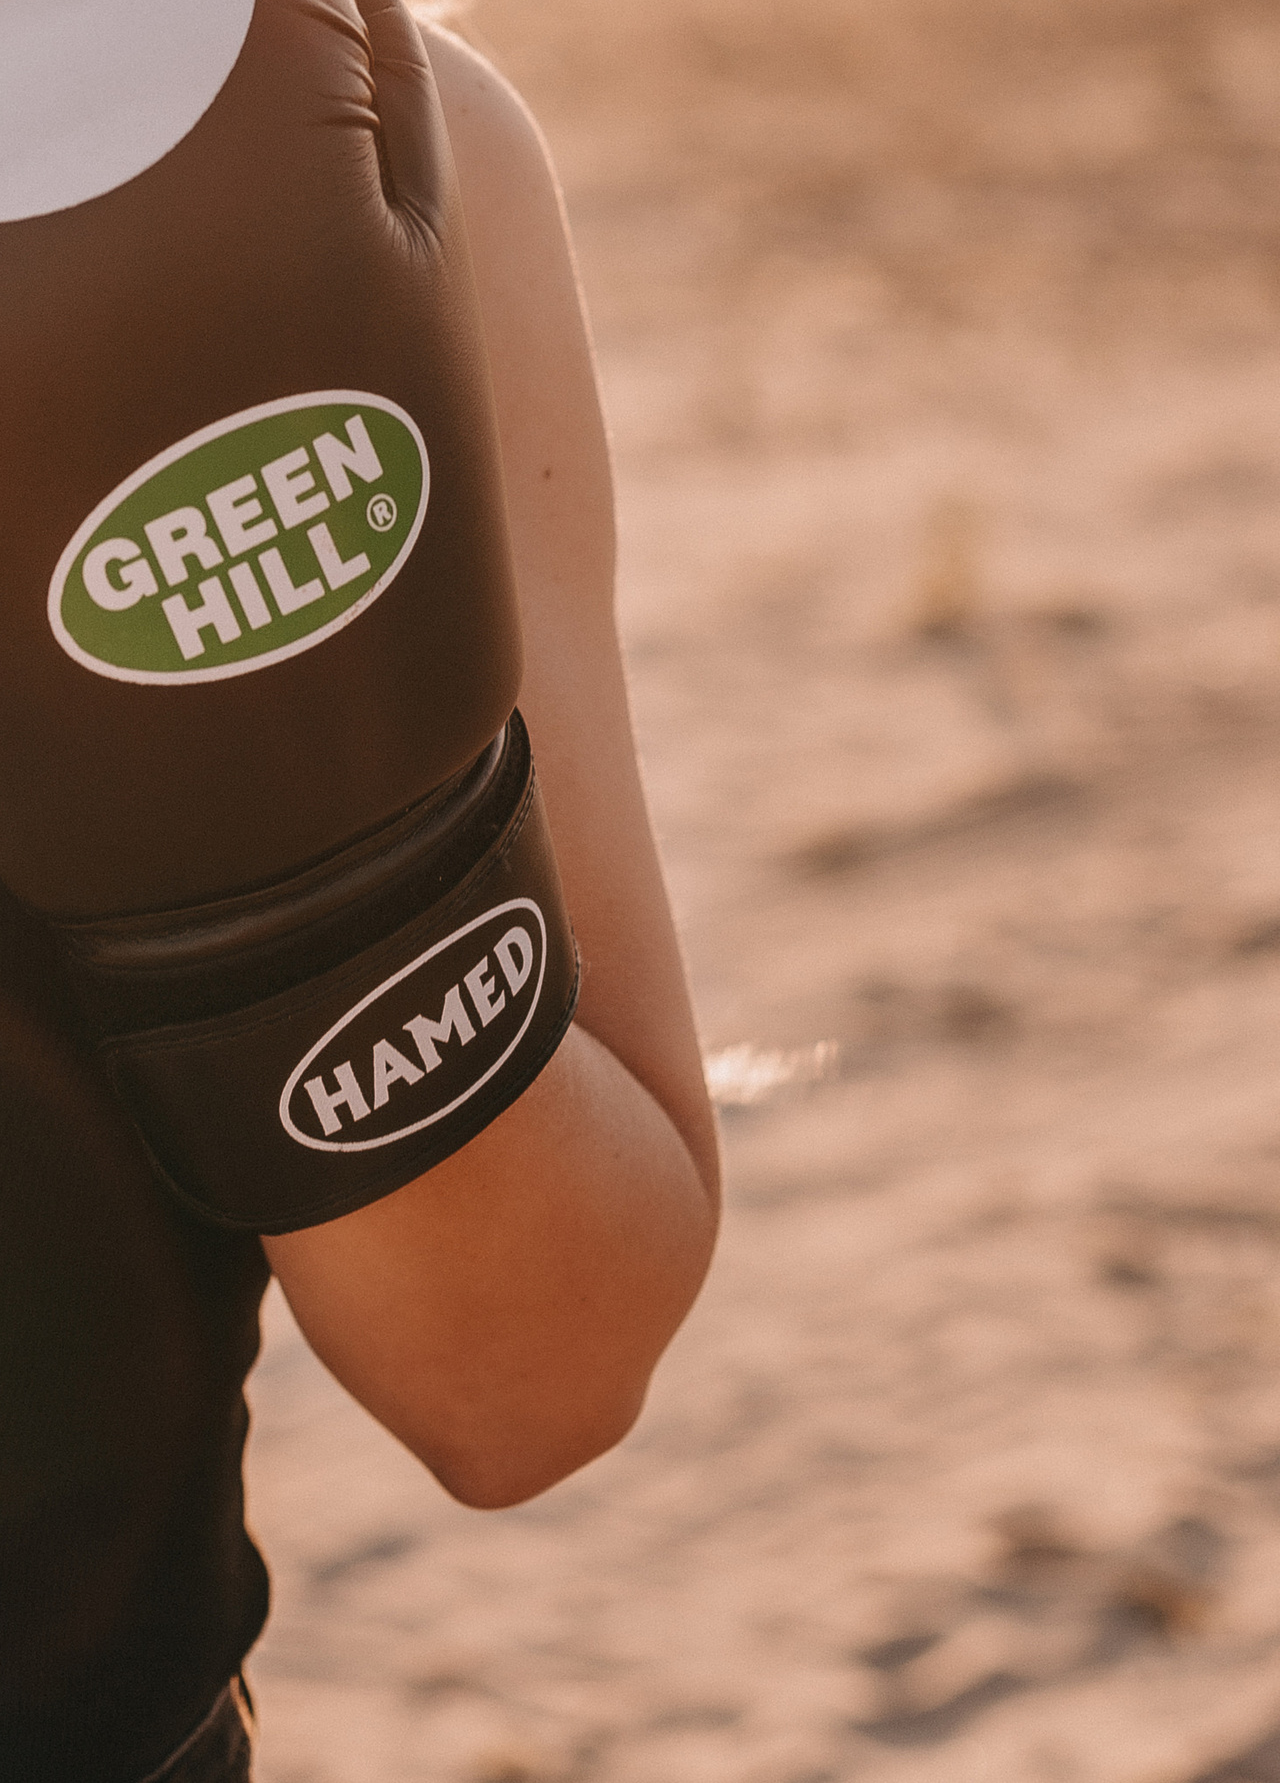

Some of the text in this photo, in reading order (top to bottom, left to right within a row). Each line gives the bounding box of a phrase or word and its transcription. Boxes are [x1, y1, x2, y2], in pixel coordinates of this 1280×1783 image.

[82, 414, 384, 612] GREEN
[161, 522, 372, 662] HILL
[303, 926, 534, 1137] HAMED
